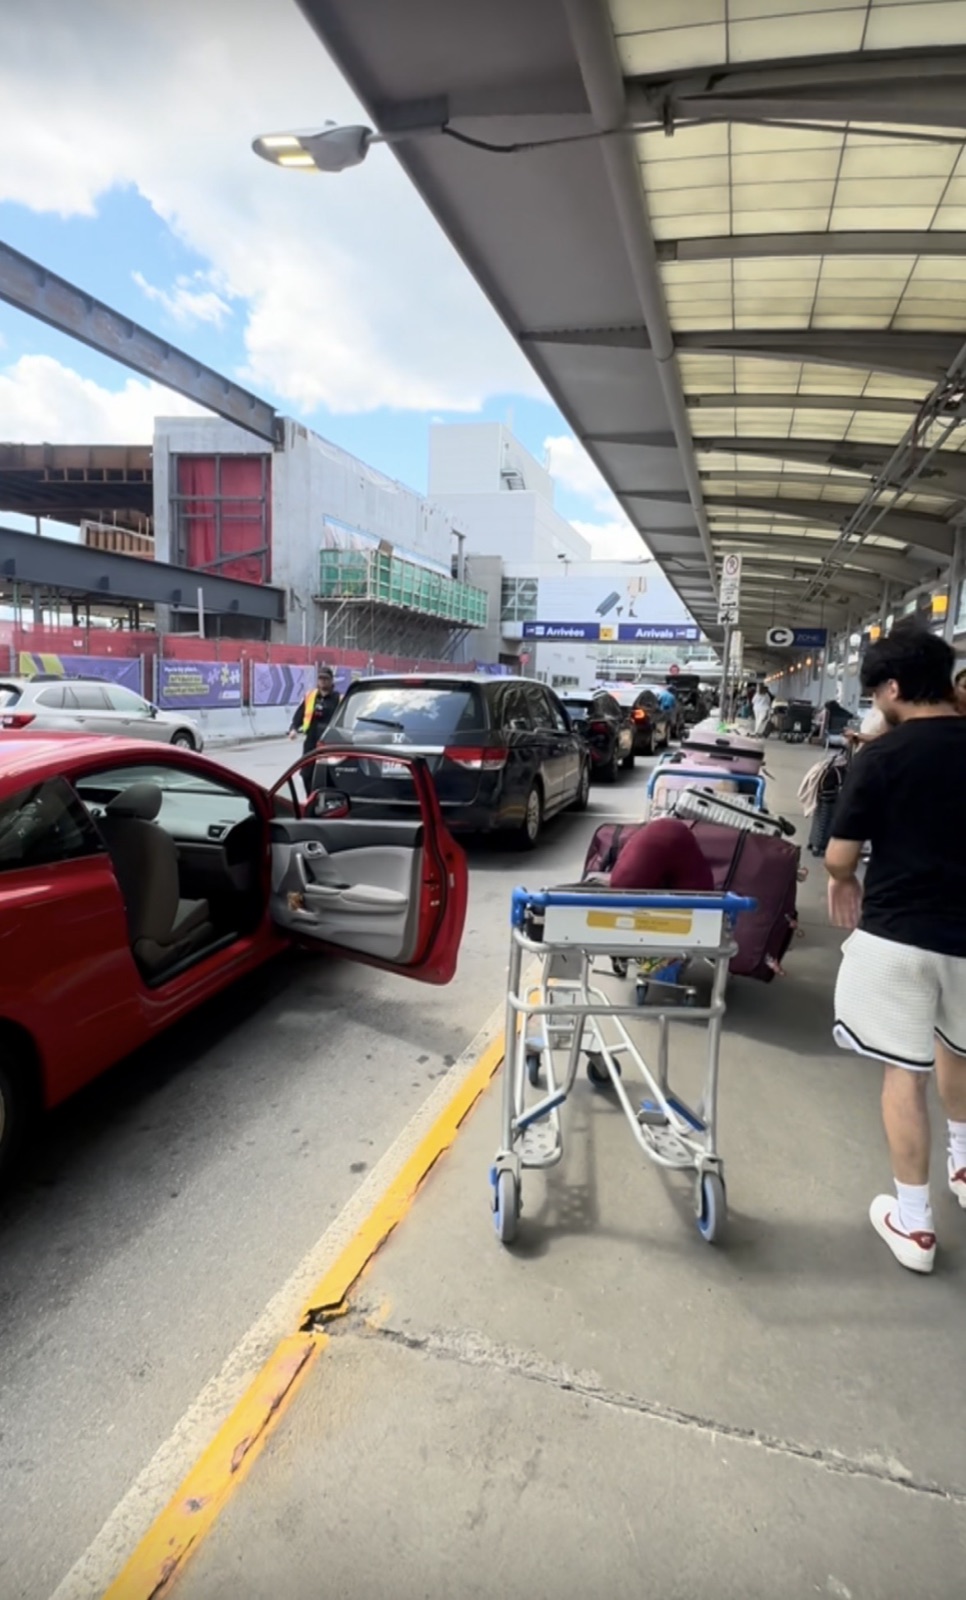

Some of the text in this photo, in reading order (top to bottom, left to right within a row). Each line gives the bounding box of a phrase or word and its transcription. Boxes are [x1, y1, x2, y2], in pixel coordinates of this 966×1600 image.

[546, 627, 585, 637] Arrivées
[635, 629, 674, 639] Arrivals
[770, 630, 787, 643] C
